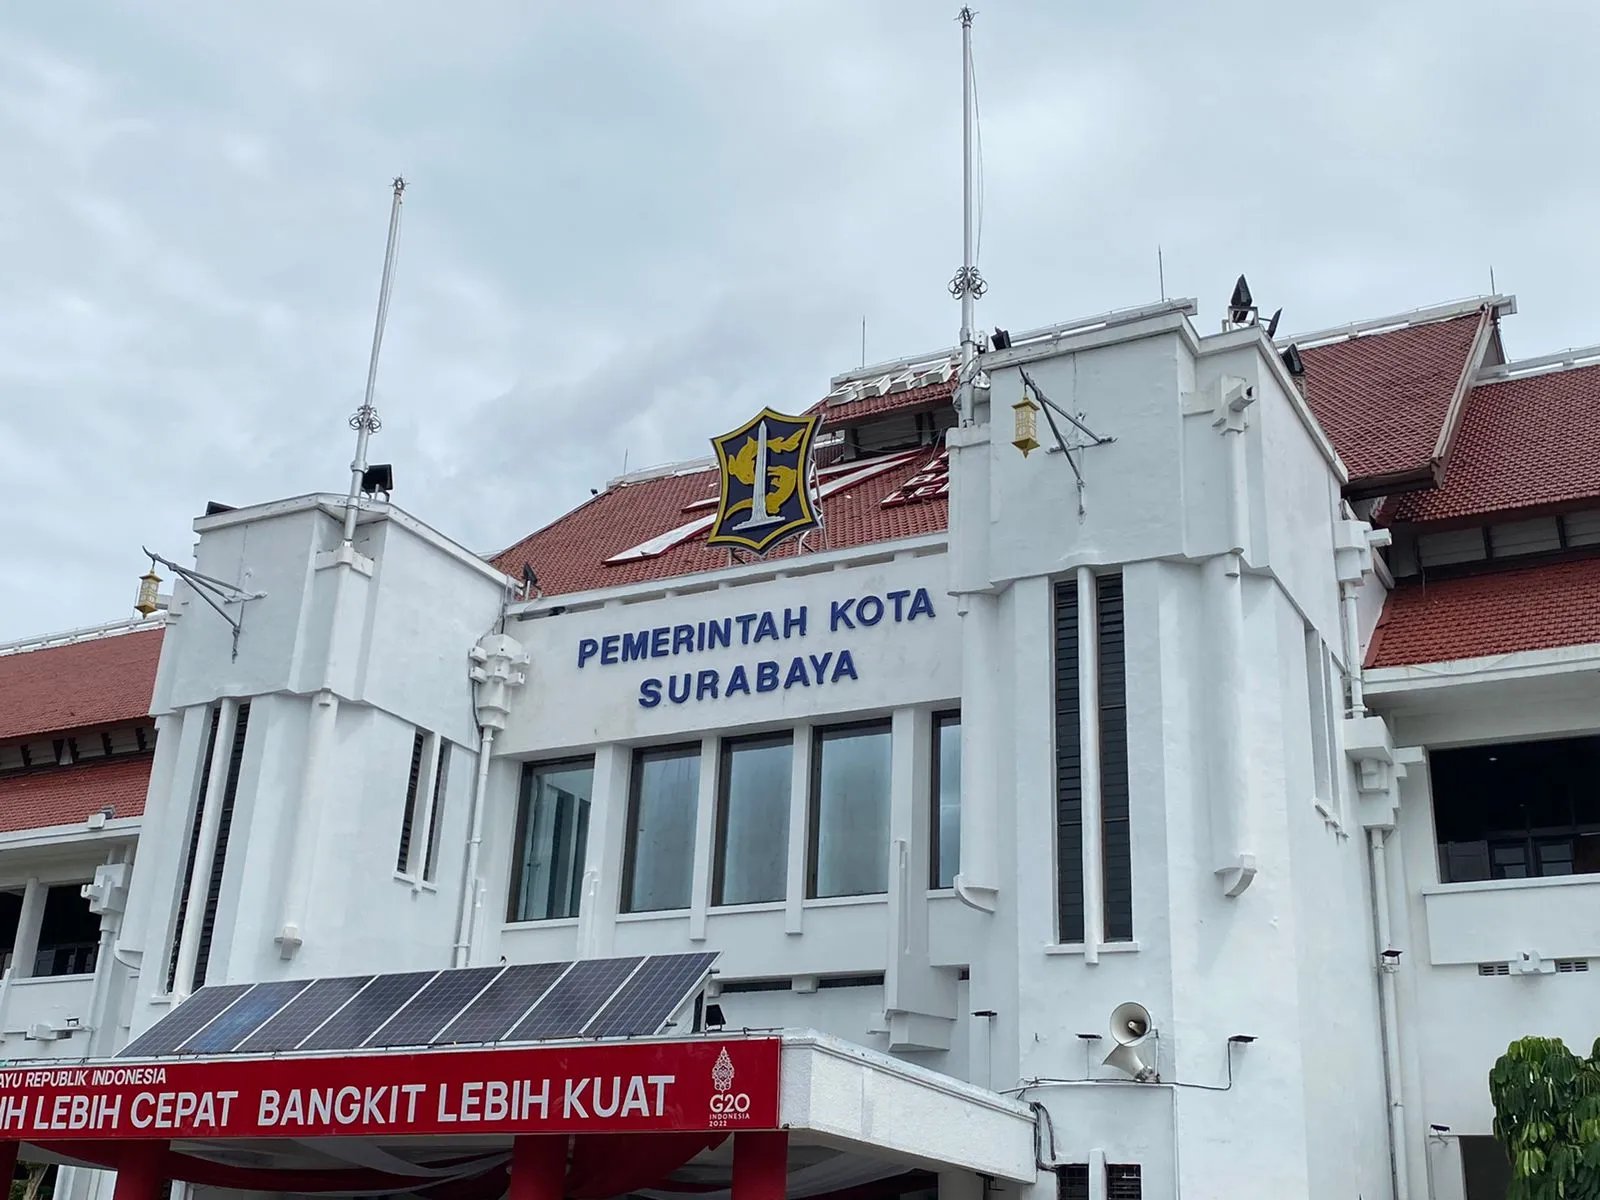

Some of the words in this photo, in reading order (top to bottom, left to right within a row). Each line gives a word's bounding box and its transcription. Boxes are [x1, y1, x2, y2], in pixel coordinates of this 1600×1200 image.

[577, 605, 808, 669] PEMERINTAH
[830, 587, 937, 633] KOTA
[638, 649, 859, 709] SURABAYA
[25, 1070, 89, 1088] REPUBLIK
[92, 1068, 167, 1086] INDONESIA
[33, 1094, 122, 1130] LEBIH
[130, 1090, 239, 1129] CEPAT
[257, 1084, 427, 1126] BANGKIT
[437, 1078, 550, 1122] LEBIH
[562, 1075, 676, 1119] KUAT
[709, 1093, 751, 1113] G20
